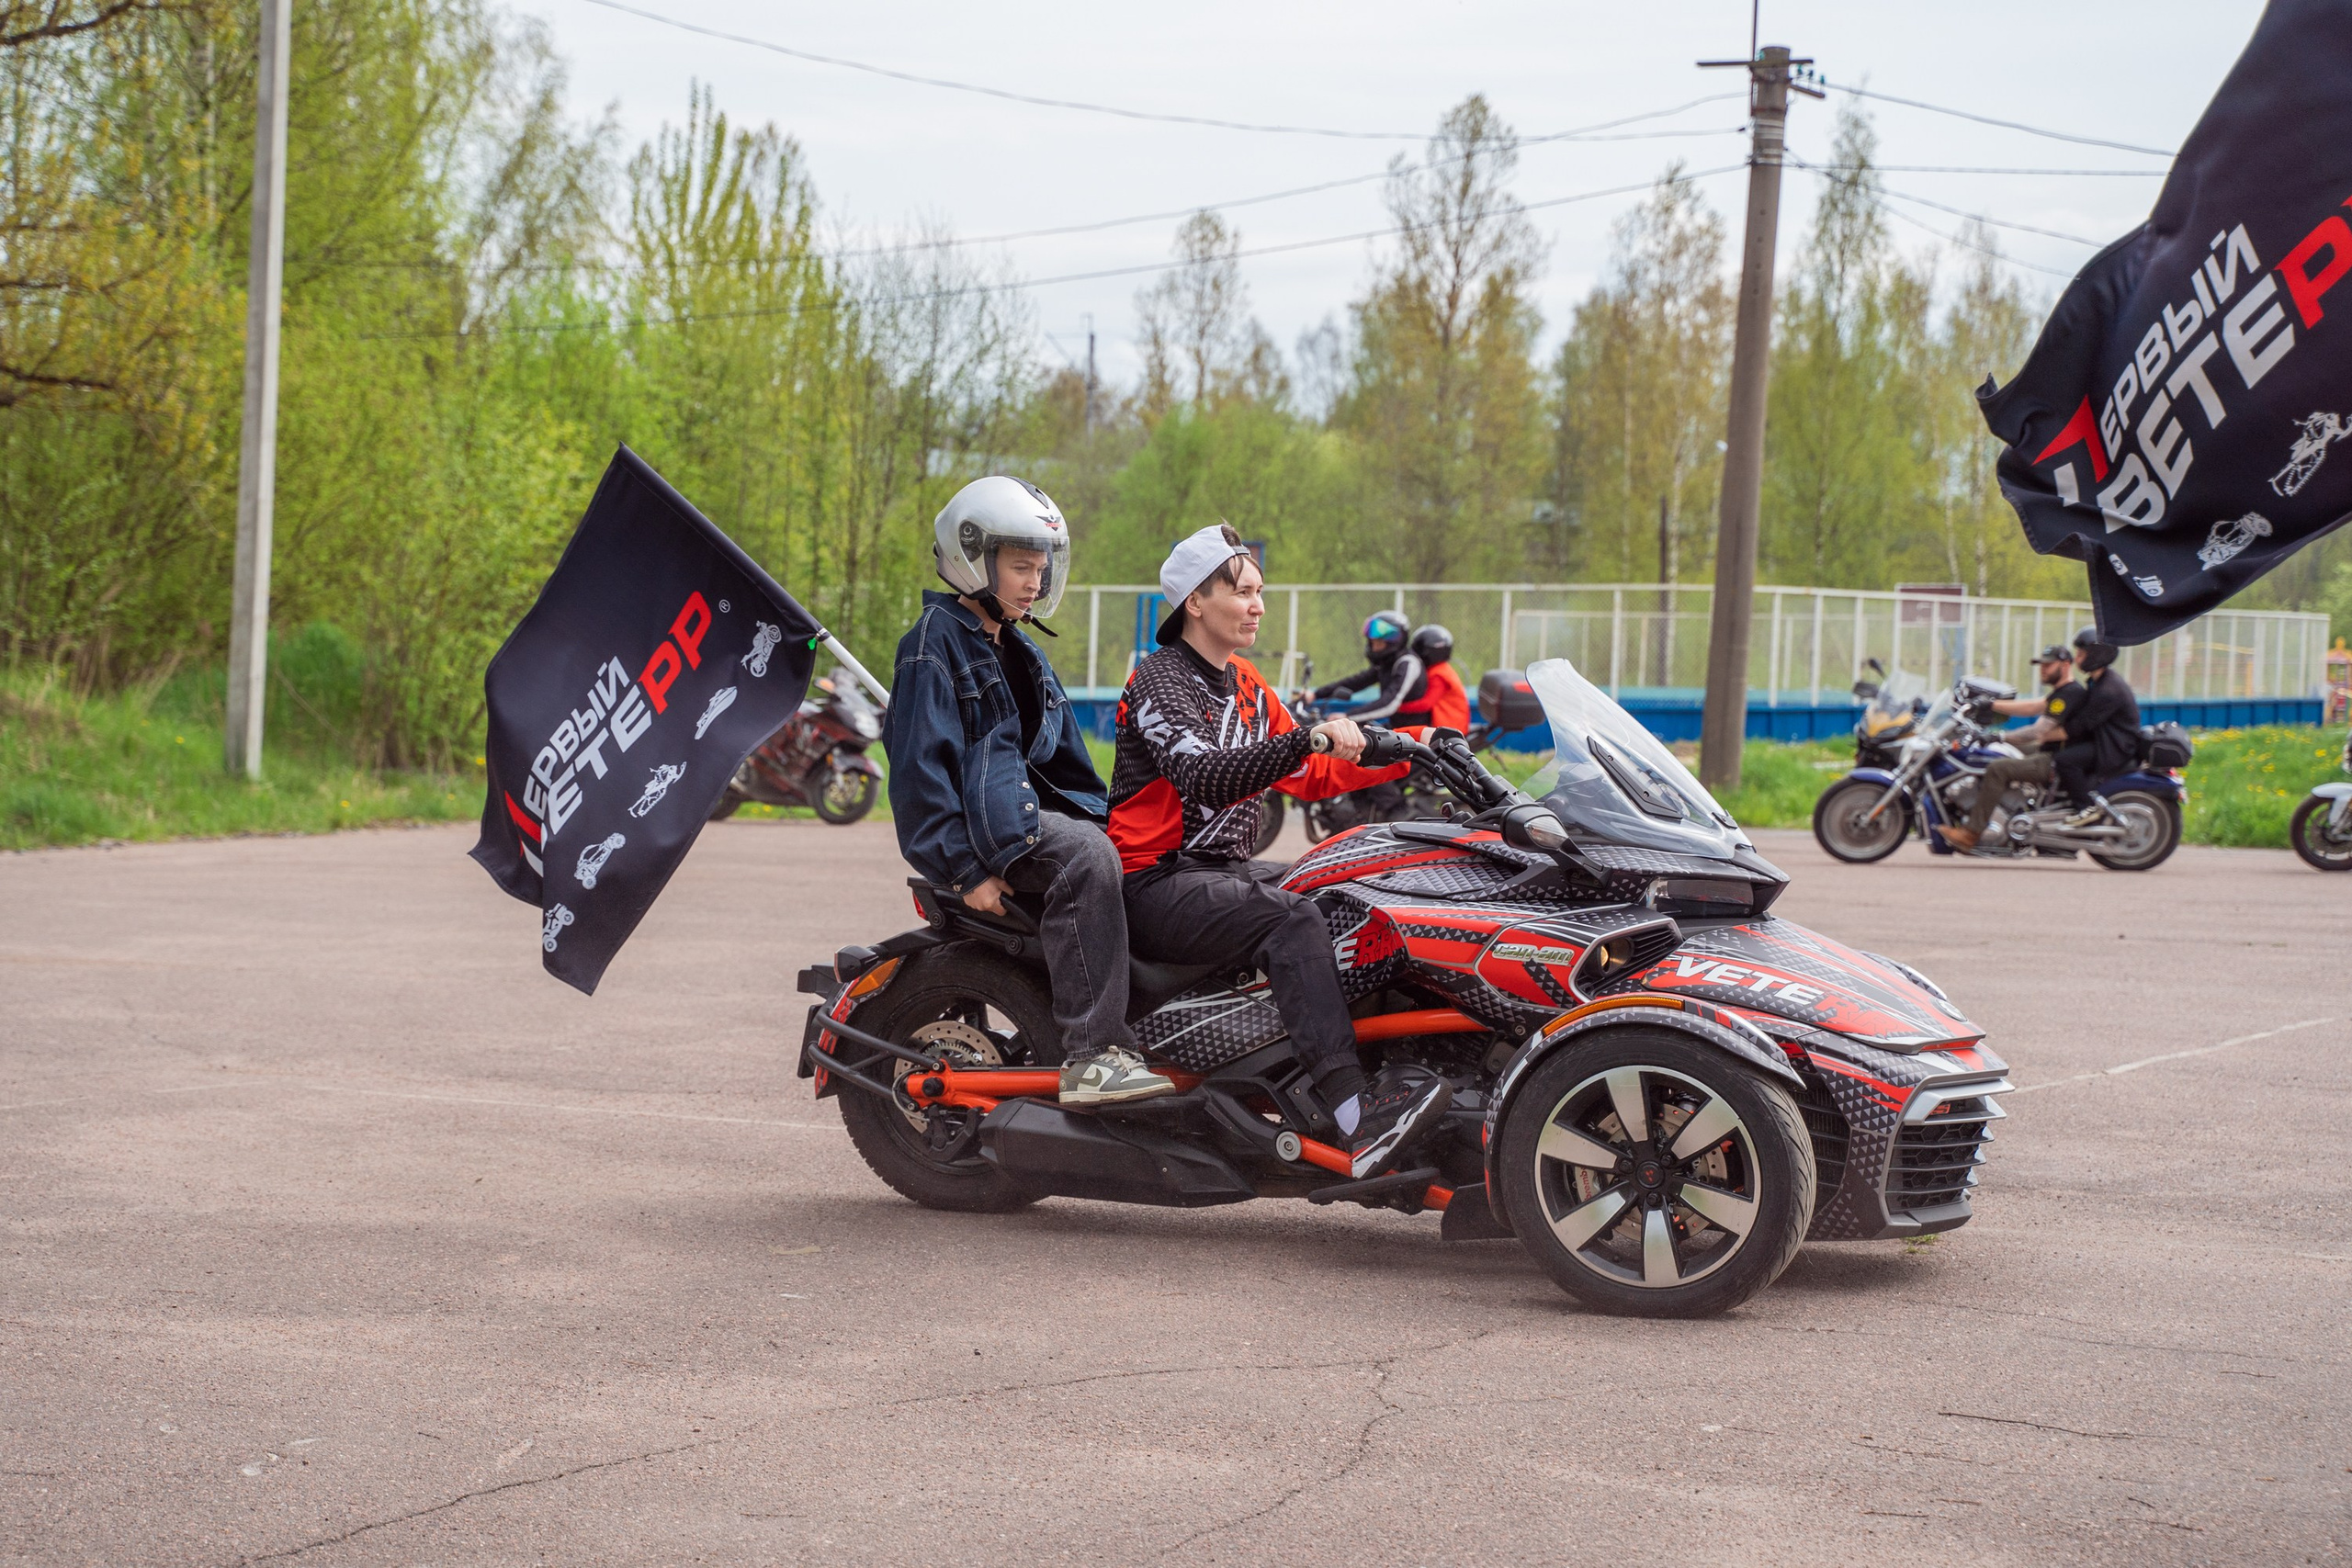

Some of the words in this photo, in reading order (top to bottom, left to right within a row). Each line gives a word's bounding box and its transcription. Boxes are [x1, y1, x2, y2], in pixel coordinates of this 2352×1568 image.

[2097, 195, 2352, 534] ВЕТЕР
[542, 591, 712, 852] ЕТЕРР
[1493, 943, 1574, 964] can-am
